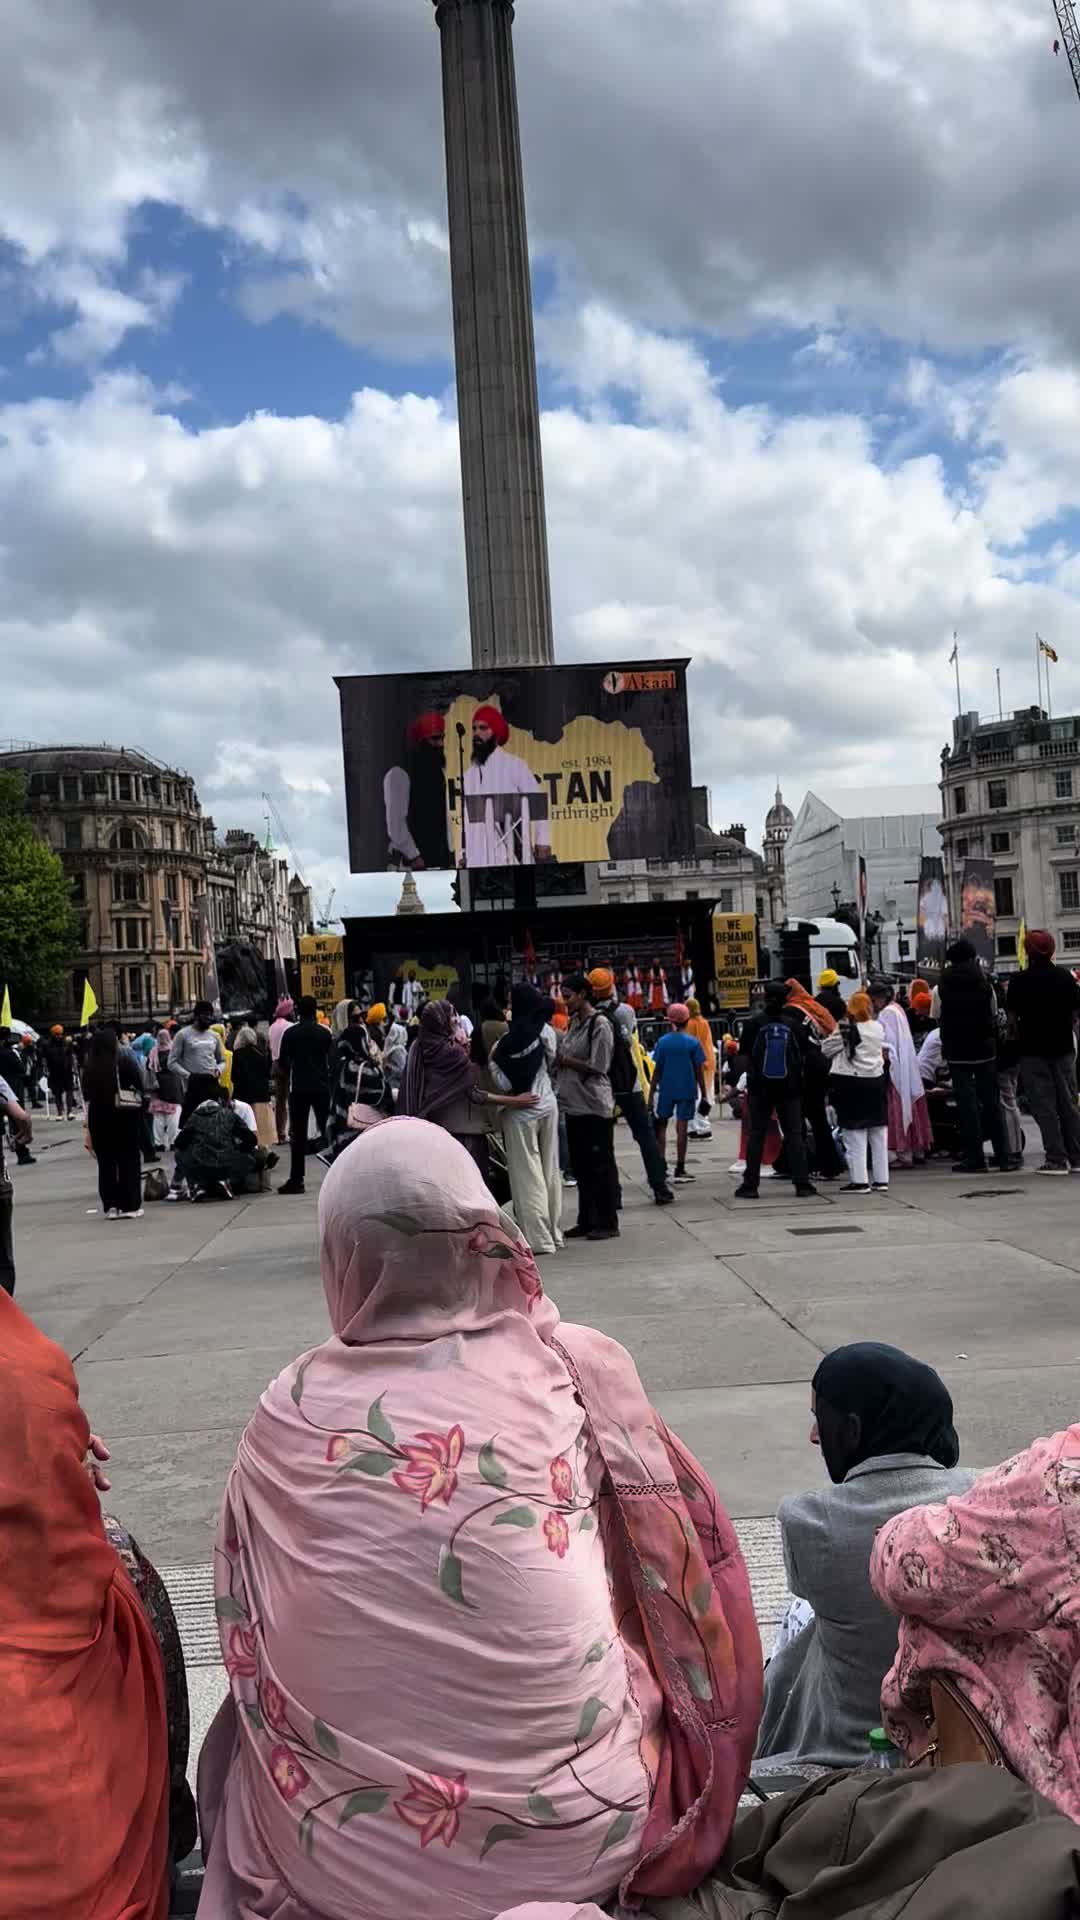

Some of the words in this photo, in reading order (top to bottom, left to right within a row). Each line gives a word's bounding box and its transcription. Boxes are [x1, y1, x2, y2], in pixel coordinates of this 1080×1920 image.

[625, 672, 675, 689] Akaal
[585, 755, 613, 767] 1984
[550, 804, 614, 823] irthright
[727, 920, 741, 930] WE
[716, 931, 753, 943] DEMAND
[315, 941, 327, 951] WE
[724, 953, 748, 966] SIKH
[311, 975, 335, 987] 1984
